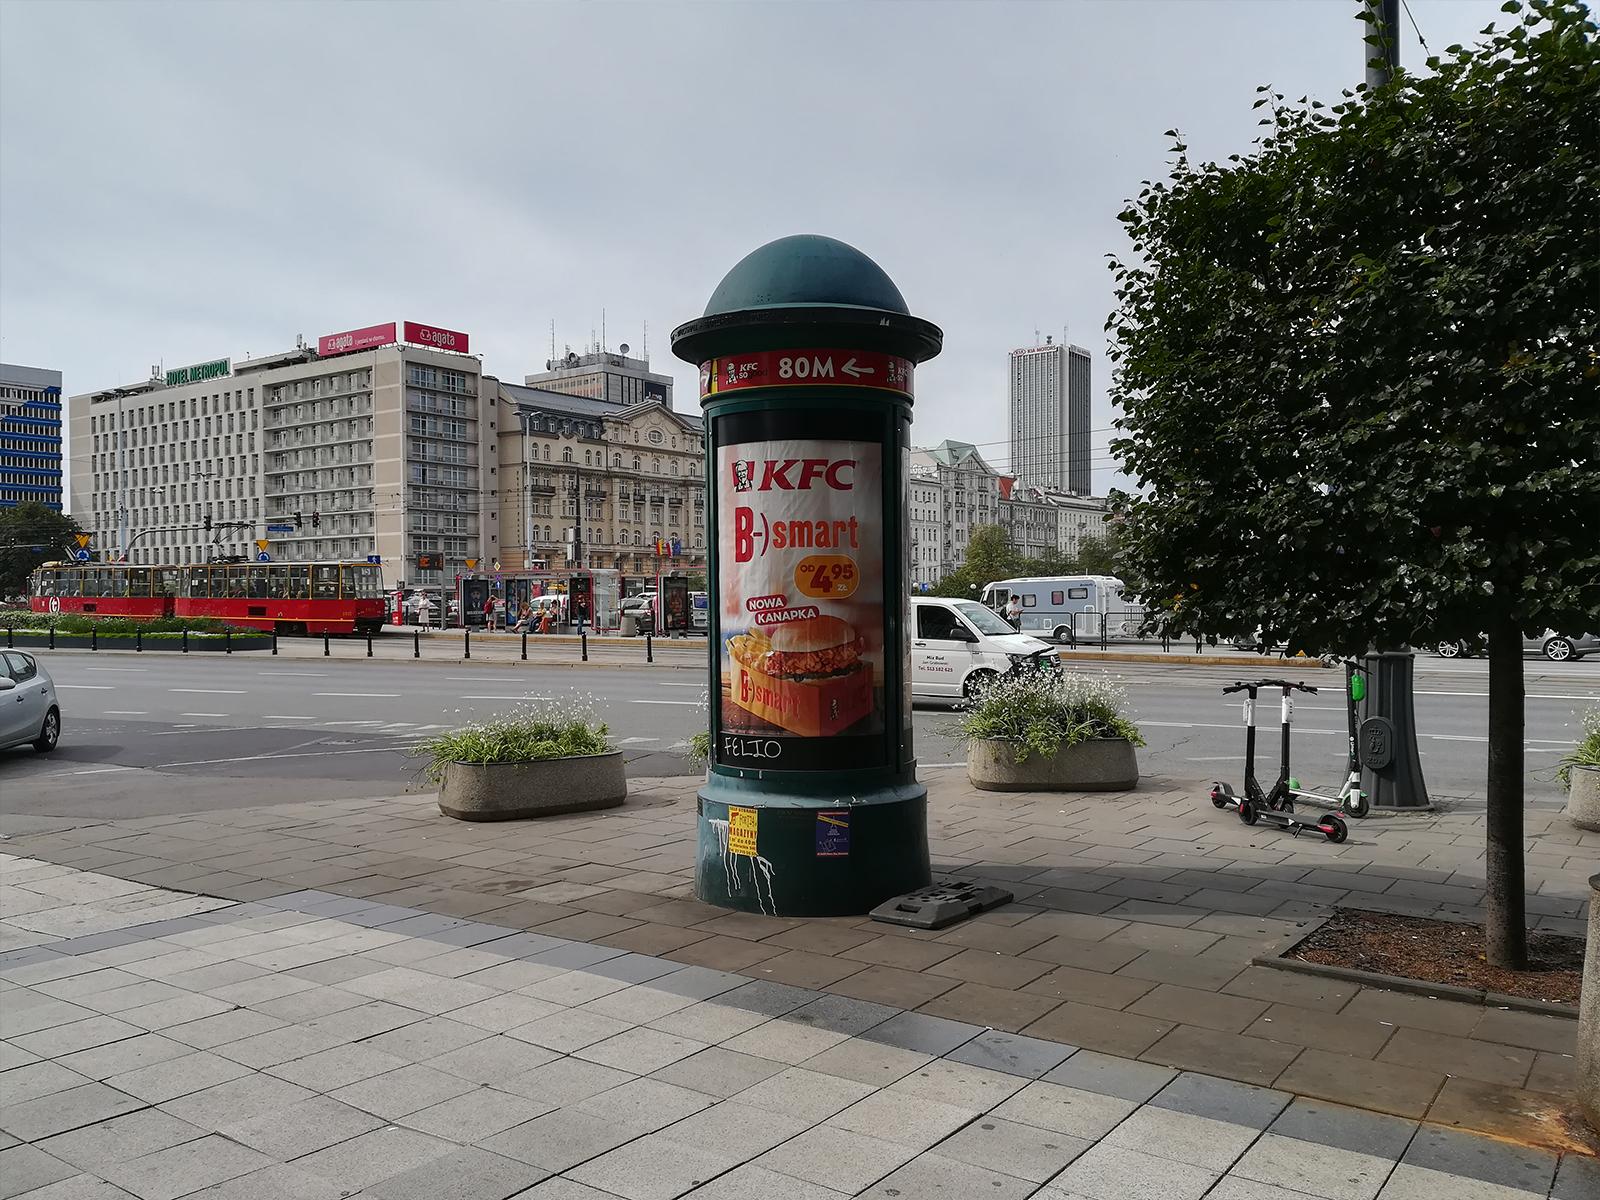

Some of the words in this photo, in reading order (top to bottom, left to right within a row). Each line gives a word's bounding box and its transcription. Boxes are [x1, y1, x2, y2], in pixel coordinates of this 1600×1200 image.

[335, 334, 353, 351] agata
[432, 331, 455, 347] agata
[166, 369, 189, 386] HOTEL
[190, 360, 229, 382] METROPOL
[739, 362, 759, 372] KFC
[778, 356, 835, 379] 80M
[757, 459, 855, 491] KFC
[800, 564, 815, 573] OD
[749, 598, 784, 611] NOWA
[757, 608, 817, 624] KANAPKA
[724, 736, 782, 759] FELIO
